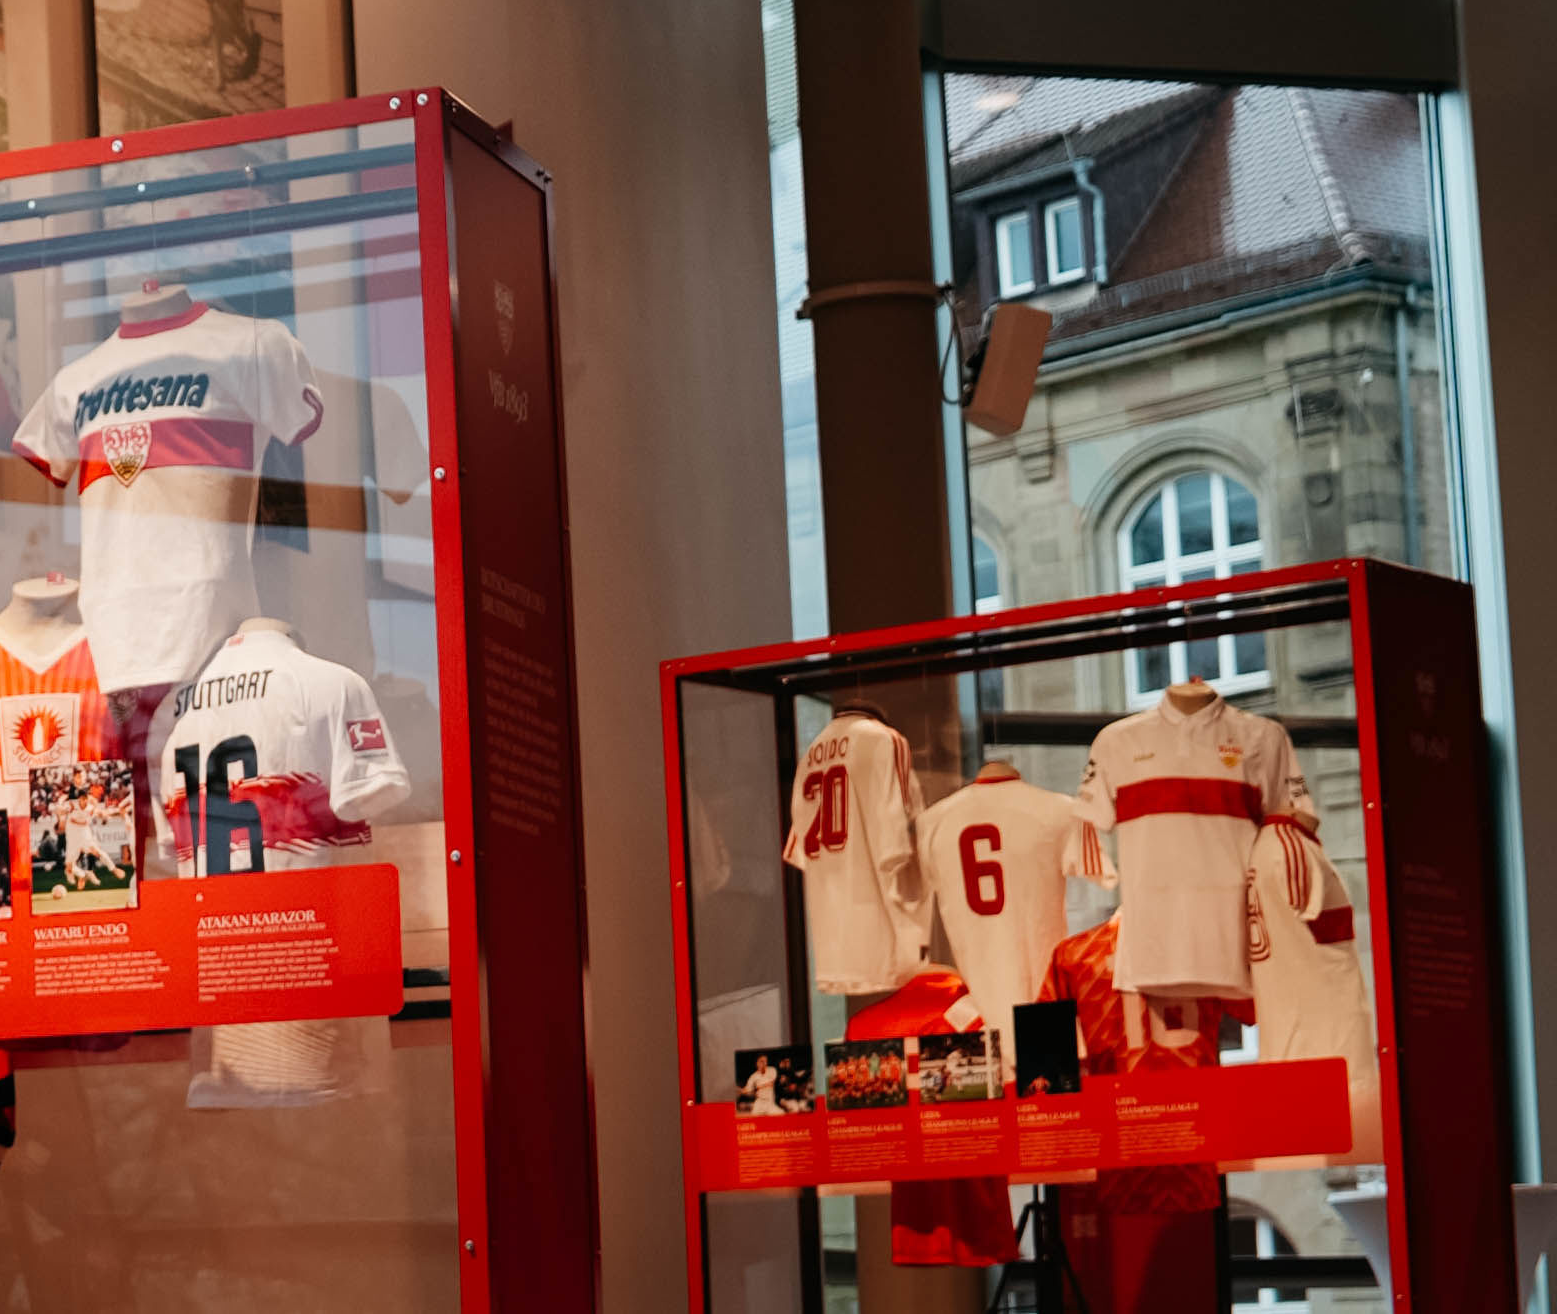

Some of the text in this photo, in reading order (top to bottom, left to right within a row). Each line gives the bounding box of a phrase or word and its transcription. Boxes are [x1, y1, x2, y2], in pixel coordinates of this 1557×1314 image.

[175, 734, 265, 876] 16
[803, 764, 849, 859] 20
[958, 823, 1005, 917] 6
[34, 922, 128, 940] WATARU ENDO
[197, 914, 250, 930] ATAKAN
[251, 909, 316, 925] KARAZOR
